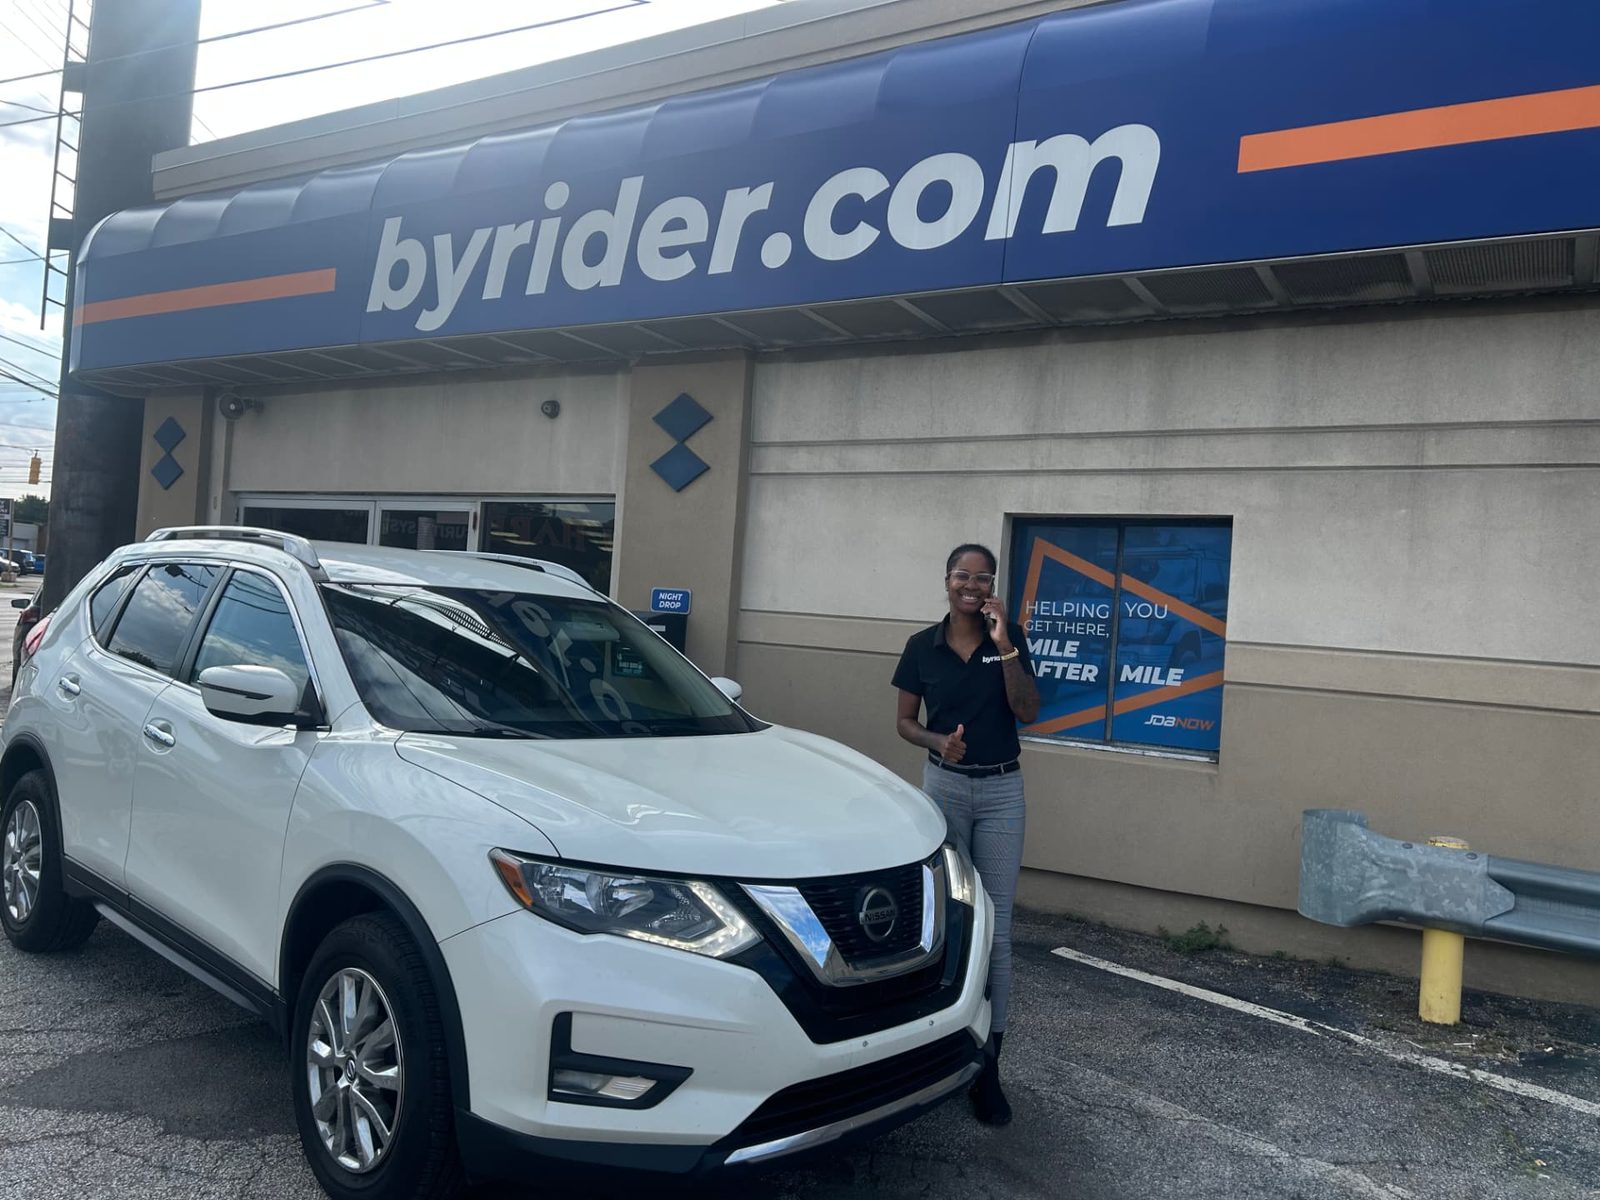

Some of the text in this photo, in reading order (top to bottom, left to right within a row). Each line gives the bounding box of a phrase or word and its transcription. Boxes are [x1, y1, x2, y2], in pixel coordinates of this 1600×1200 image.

[365, 123, 1162, 332] byrider.com
[659, 592, 683, 600] NIGHT
[659, 601, 682, 609] DROP
[1025, 600, 1168, 620] HELPING YOU
[1023, 619, 1110, 638] GET THERE,
[1030, 660, 1185, 687] FTER MILE
